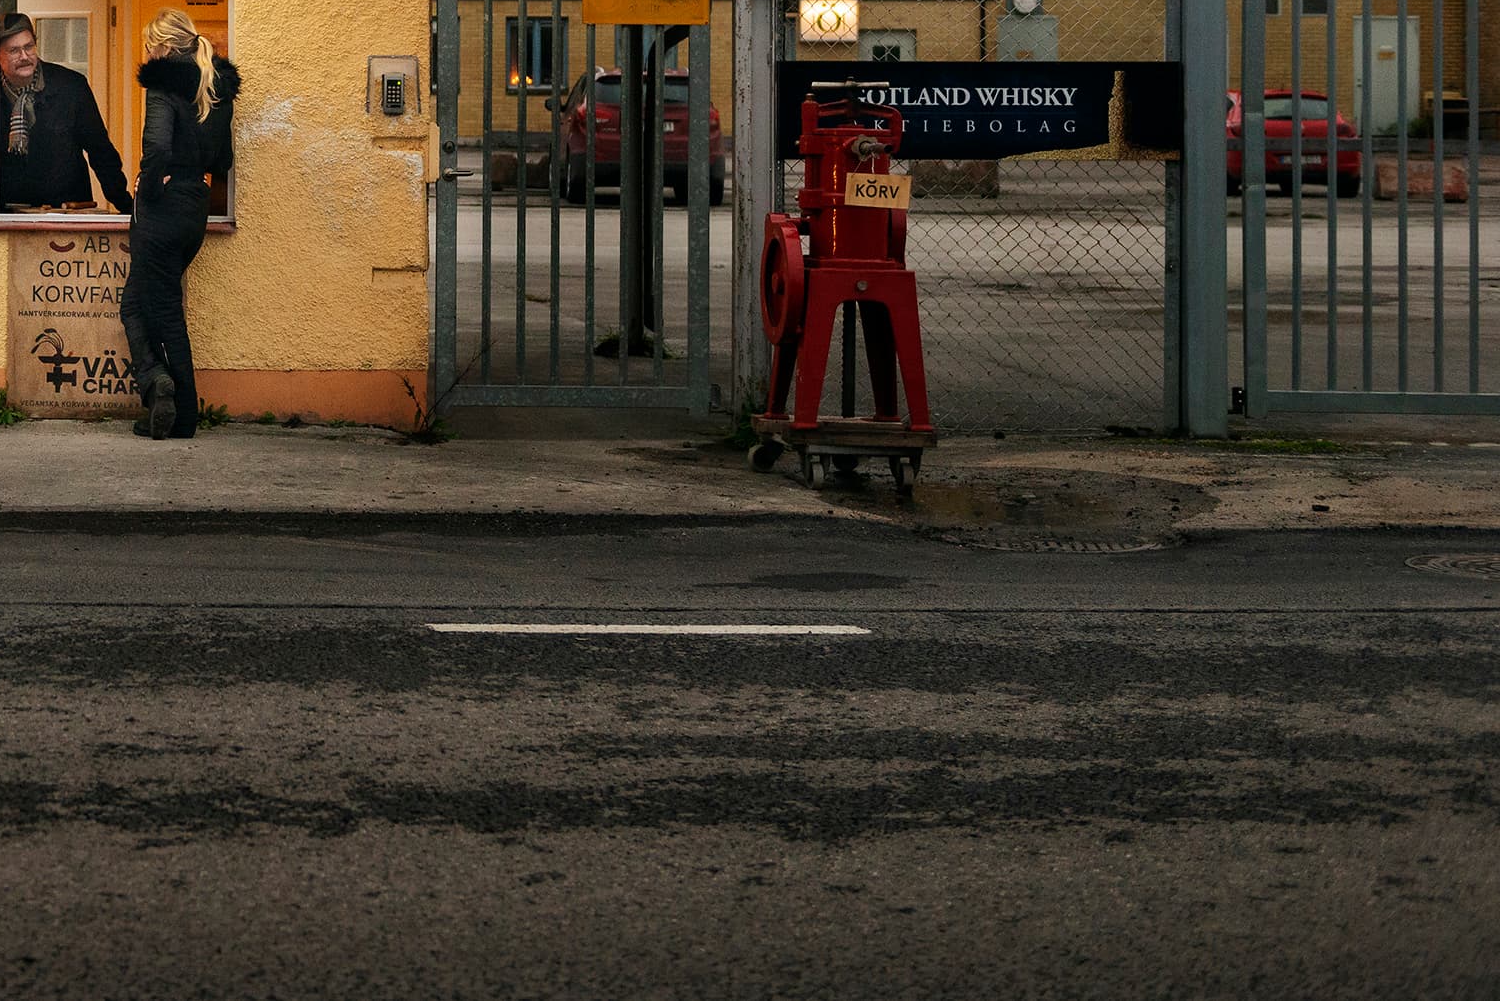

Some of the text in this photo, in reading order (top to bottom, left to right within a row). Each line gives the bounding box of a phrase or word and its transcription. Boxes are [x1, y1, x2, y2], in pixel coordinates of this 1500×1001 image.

[975, 87, 1078, 106] WHISKY
[853, 119, 1076, 132] KTIEBOLAG
[83, 236, 110, 253] AB
[39, 260, 127, 278] GOTLAN
[18, 310, 90, 318] HANTVERKSKORVAR
[82, 350, 133, 379] VÄX
[83, 379, 141, 394] CHAR
